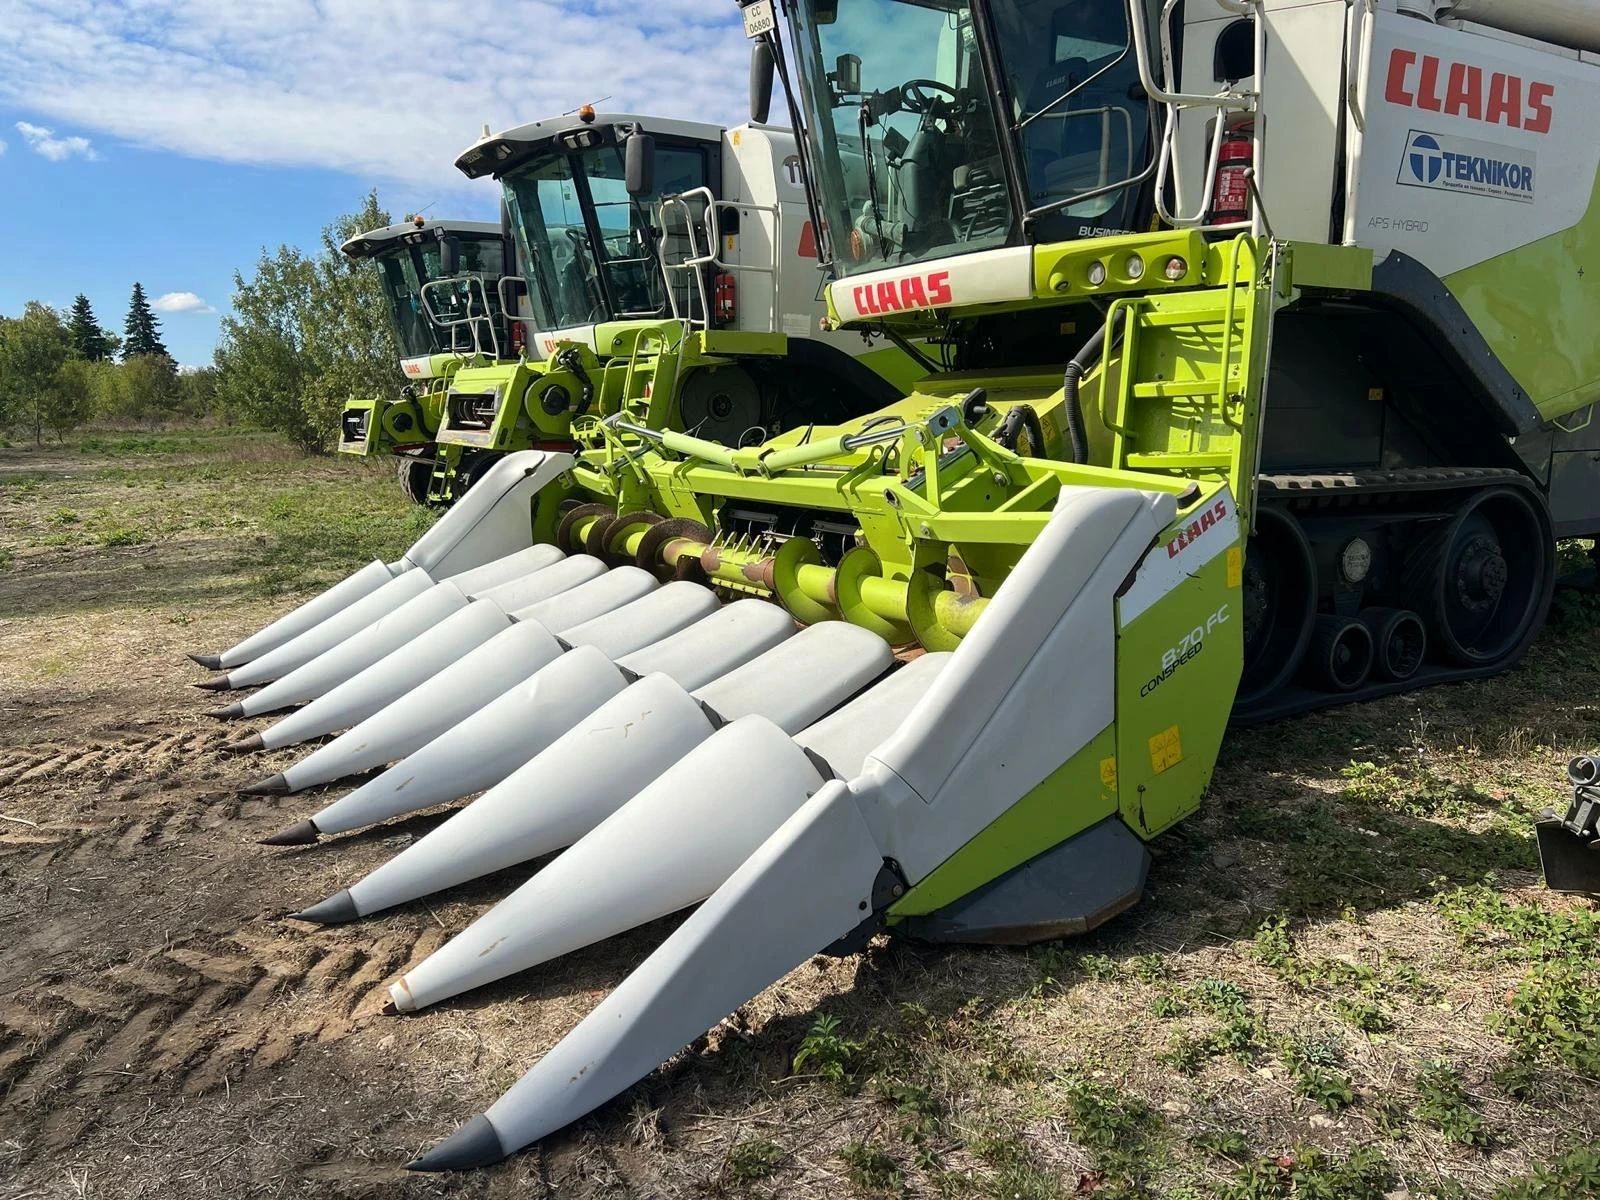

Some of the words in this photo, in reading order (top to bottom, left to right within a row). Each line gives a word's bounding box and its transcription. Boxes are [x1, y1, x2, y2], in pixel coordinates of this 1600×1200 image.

[1385, 48, 1554, 133] CLAAS
[1368, 217, 1390, 229] APS
[1393, 219, 1429, 232] HYBRID
[853, 271, 952, 315] CLAAS
[1167, 500, 1227, 559] CLAAS
[1206, 604, 1230, 635] FC
[1140, 641, 1203, 698] CONSPEED
